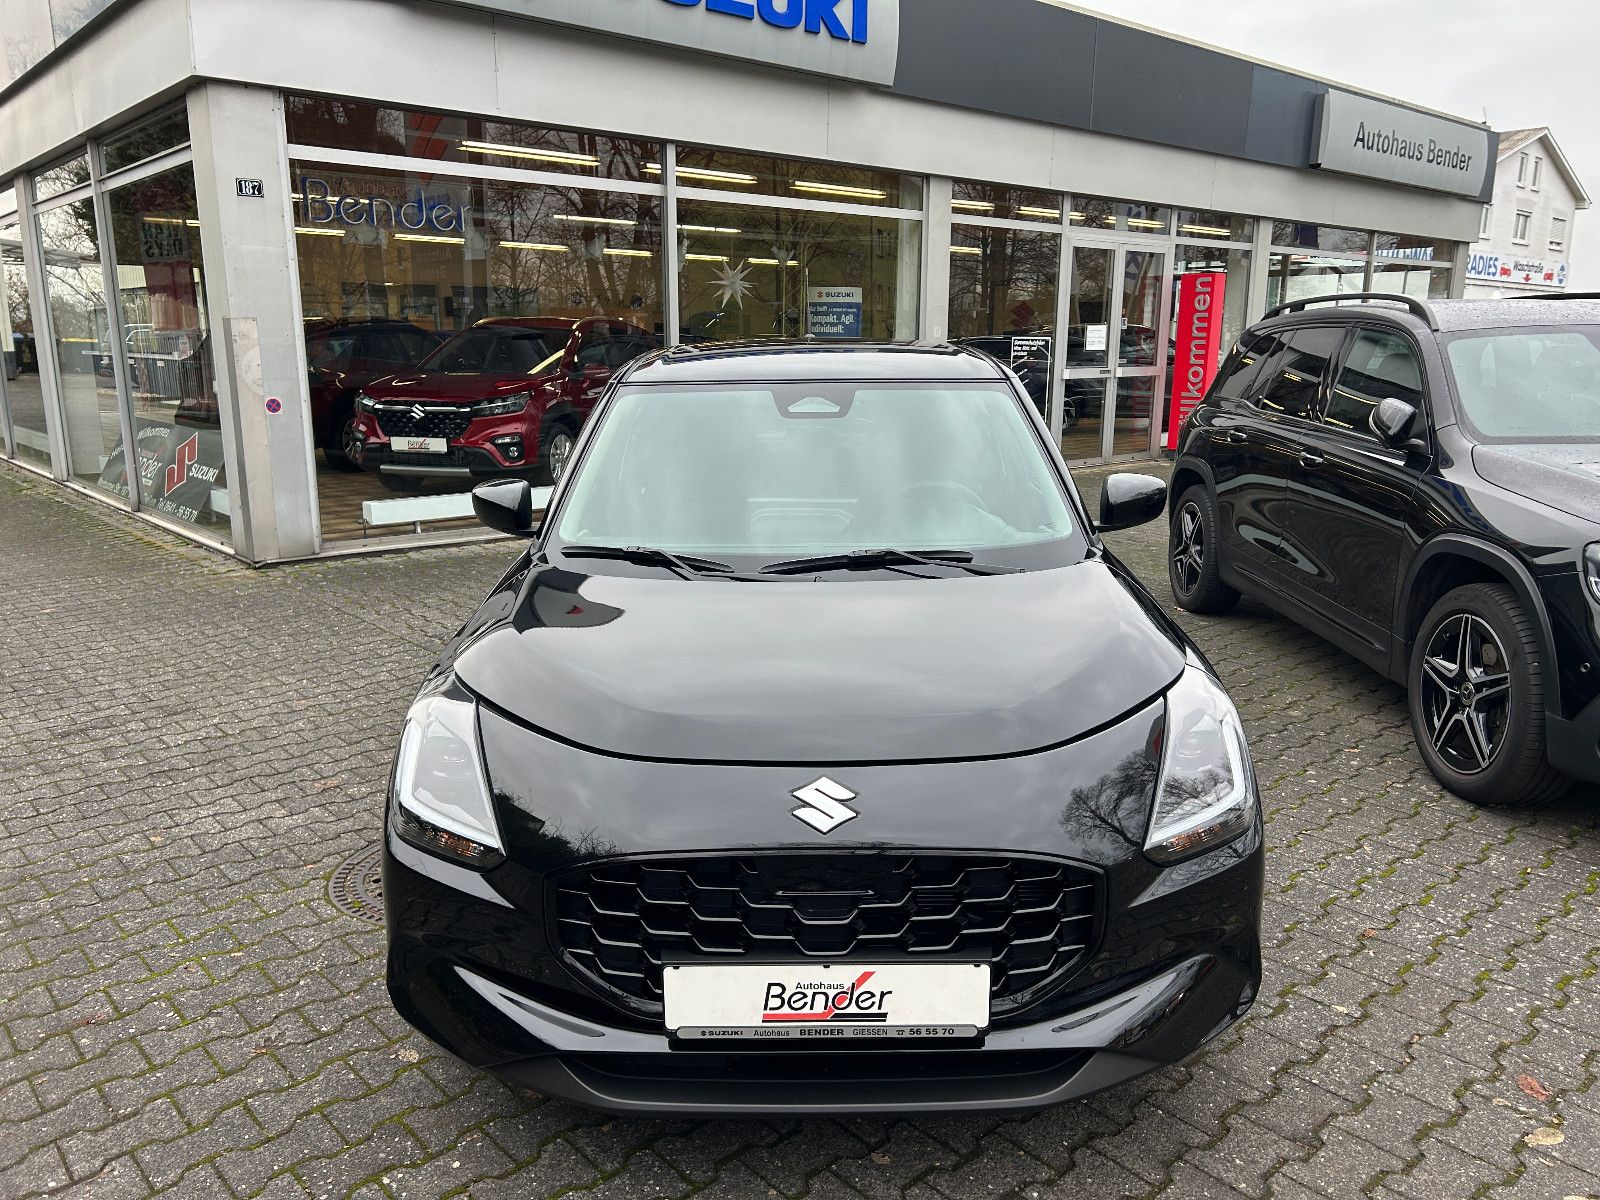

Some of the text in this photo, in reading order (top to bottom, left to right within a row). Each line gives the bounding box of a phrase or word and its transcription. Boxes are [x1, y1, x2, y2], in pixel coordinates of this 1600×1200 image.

[1353, 121, 1473, 172] Autohaus Bender
[239, 180, 260, 195] 187
[302, 176, 475, 233] Bender
[189, 463, 219, 482] SUZUKI
[795, 982, 844, 990] Autohaus
[763, 982, 892, 1011] Bender
[753, 1029, 790, 1037] Autohaus
[799, 1028, 844, 1036] BENDER
[852, 1028, 888, 1036] GIESSEN
[908, 1028, 922, 1036] 56
[925, 1028, 938, 1036] 55
[941, 1028, 955, 1036] 70
